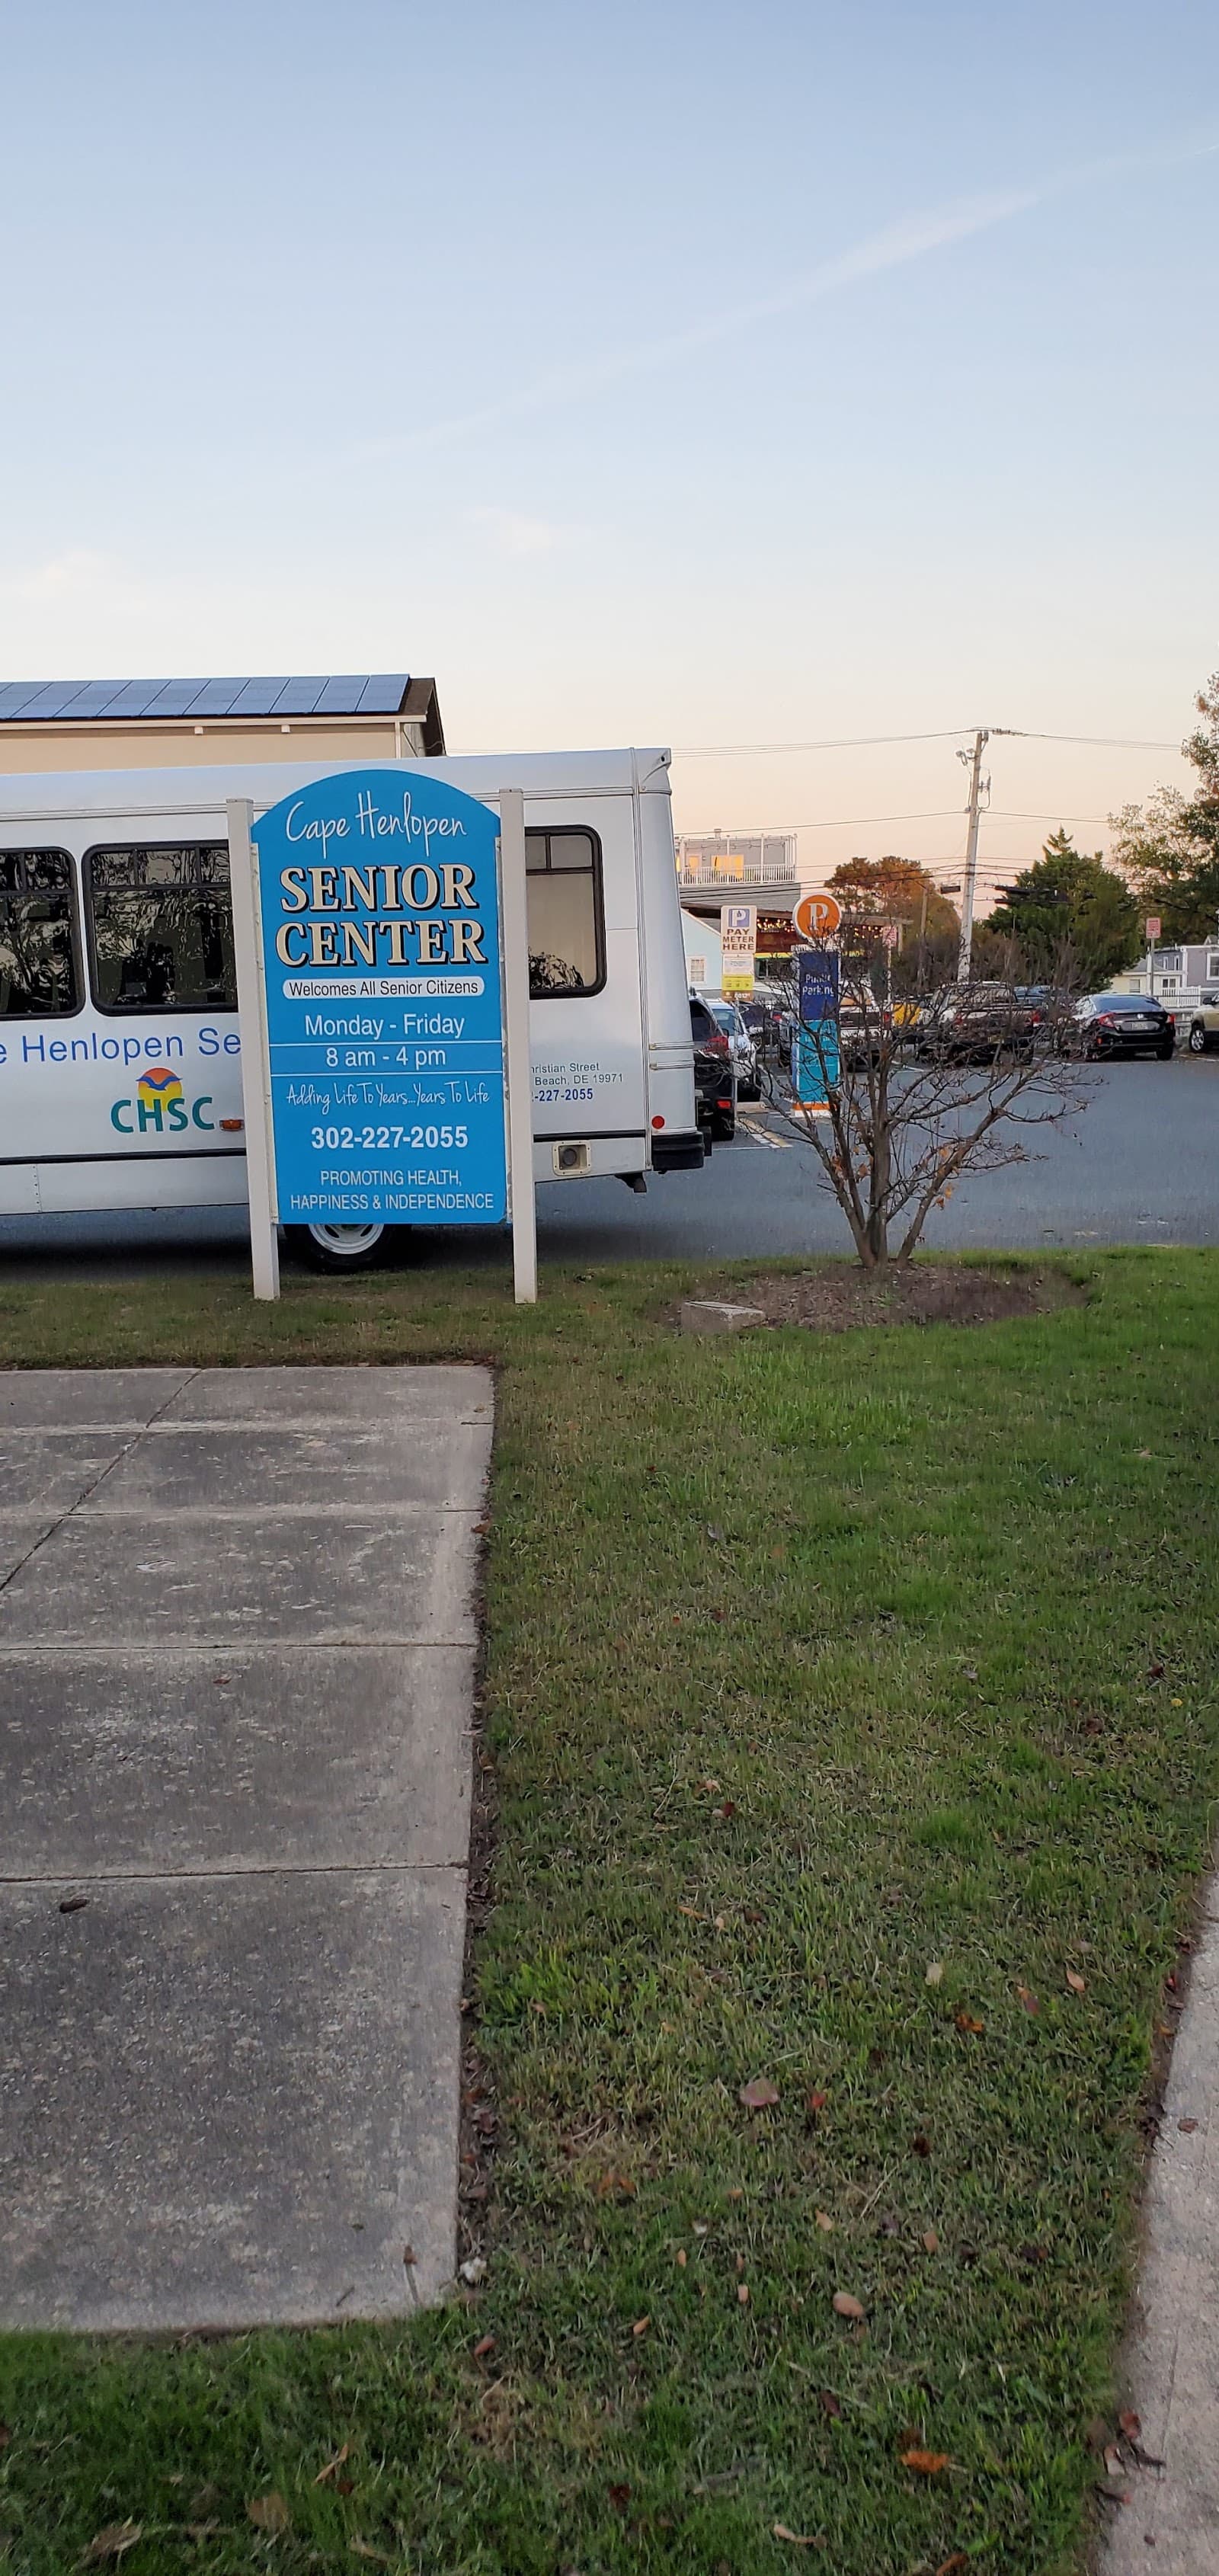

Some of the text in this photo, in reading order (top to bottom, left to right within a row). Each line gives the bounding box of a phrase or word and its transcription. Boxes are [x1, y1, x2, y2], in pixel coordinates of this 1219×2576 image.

[286, 790, 467, 859] Cape Henlopen
[280, 862, 480, 913] SENIOR
[275, 919, 488, 968] CENTER
[290, 979, 478, 997] Welcomes All Senior Citizens
[305, 1014, 384, 1040] Monday
[404, 1013, 465, 1038] Friday
[22, 1032, 184, 1066] Henlopen
[326, 1048, 338, 1067] 8
[345, 1051, 376, 1067] am
[396, 1047, 408, 1066] 4
[415, 1048, 446, 1070] pm
[535, 1073, 622, 1085] Beach, DE 19971
[569, 1062, 599, 1072] Street
[286, 1084, 331, 1115] Adding
[333, 1083, 359, 1105] Life
[359, 1082, 374, 1103] To
[445, 1081, 463, 1102] To
[465, 1082, 490, 1102] Life
[532, 1088, 594, 1102] -227-2055
[110, 1096, 216, 1133] CHSC
[311, 1125, 469, 1149] 302-227-2055
[320, 1169, 462, 1187] PROMOTING HEALTH,
[290, 1192, 494, 1210] HAPPINESS & INDEPENDENCE
